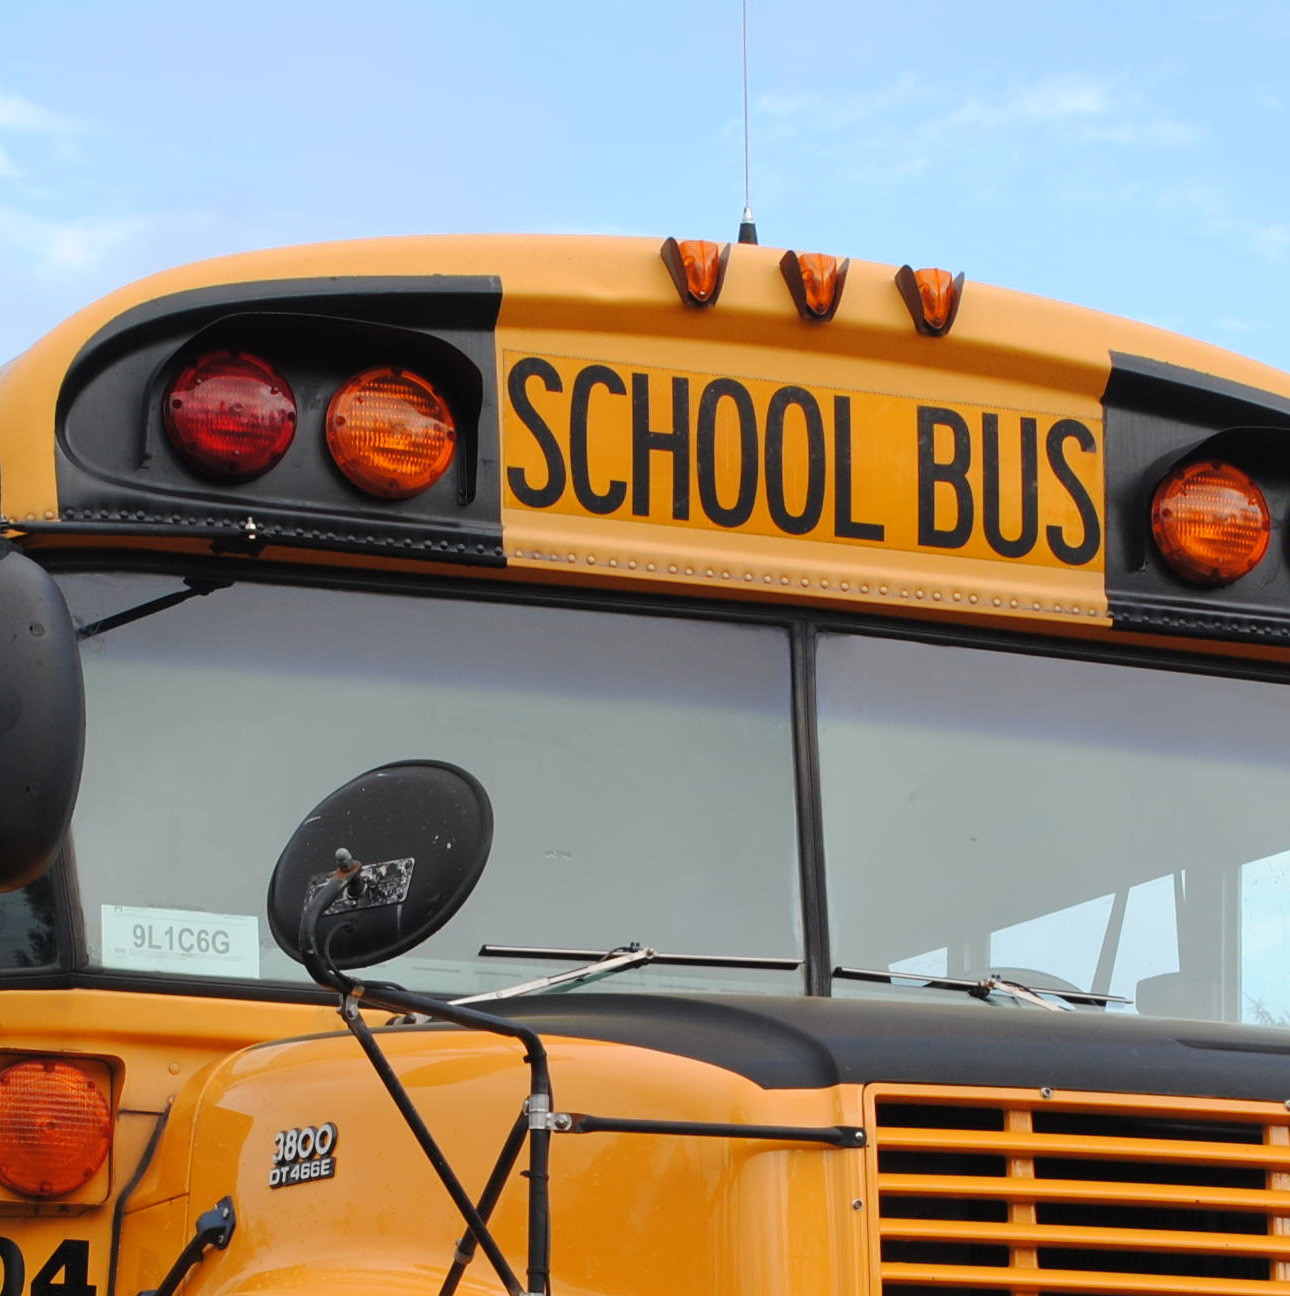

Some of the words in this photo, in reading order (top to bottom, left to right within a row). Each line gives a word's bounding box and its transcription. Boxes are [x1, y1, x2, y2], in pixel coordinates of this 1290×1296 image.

[507, 357, 884, 542] SCHOOL
[916, 405, 1101, 566] BUS
[132, 923, 230, 954] 9L1C6G
[272, 1123, 336, 1162] 3800
